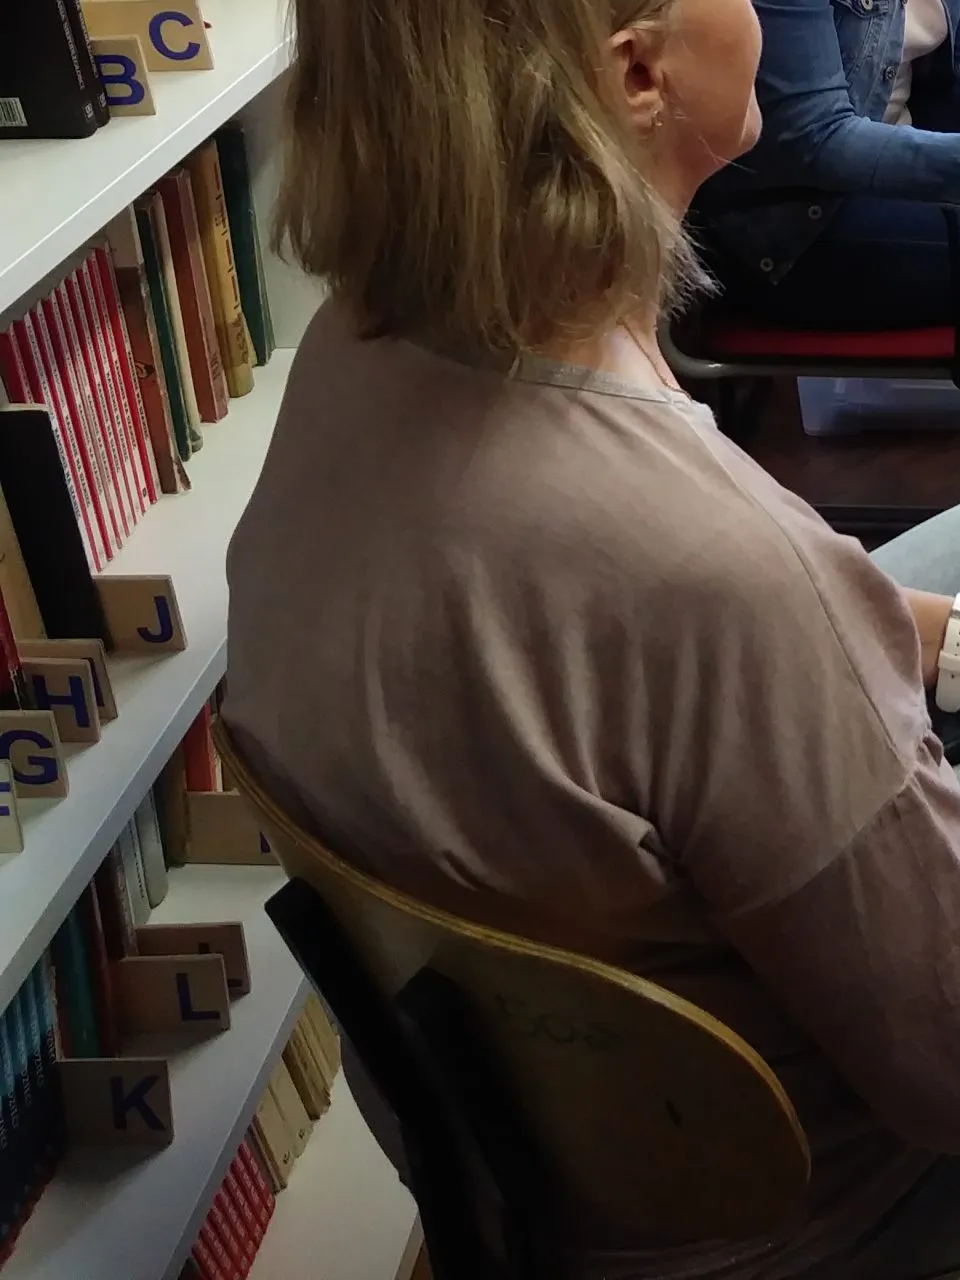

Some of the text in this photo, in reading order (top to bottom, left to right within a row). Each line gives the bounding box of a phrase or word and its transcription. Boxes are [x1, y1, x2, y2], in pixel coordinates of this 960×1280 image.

[148, 11, 200, 61] C
[94, 54, 145, 106] B
[137, 596, 173, 643] J
[32, 675, 90, 728] H
[0, 729, 58, 785] G
[176, 972, 221, 1022] L
[109, 1075, 166, 1131] K
